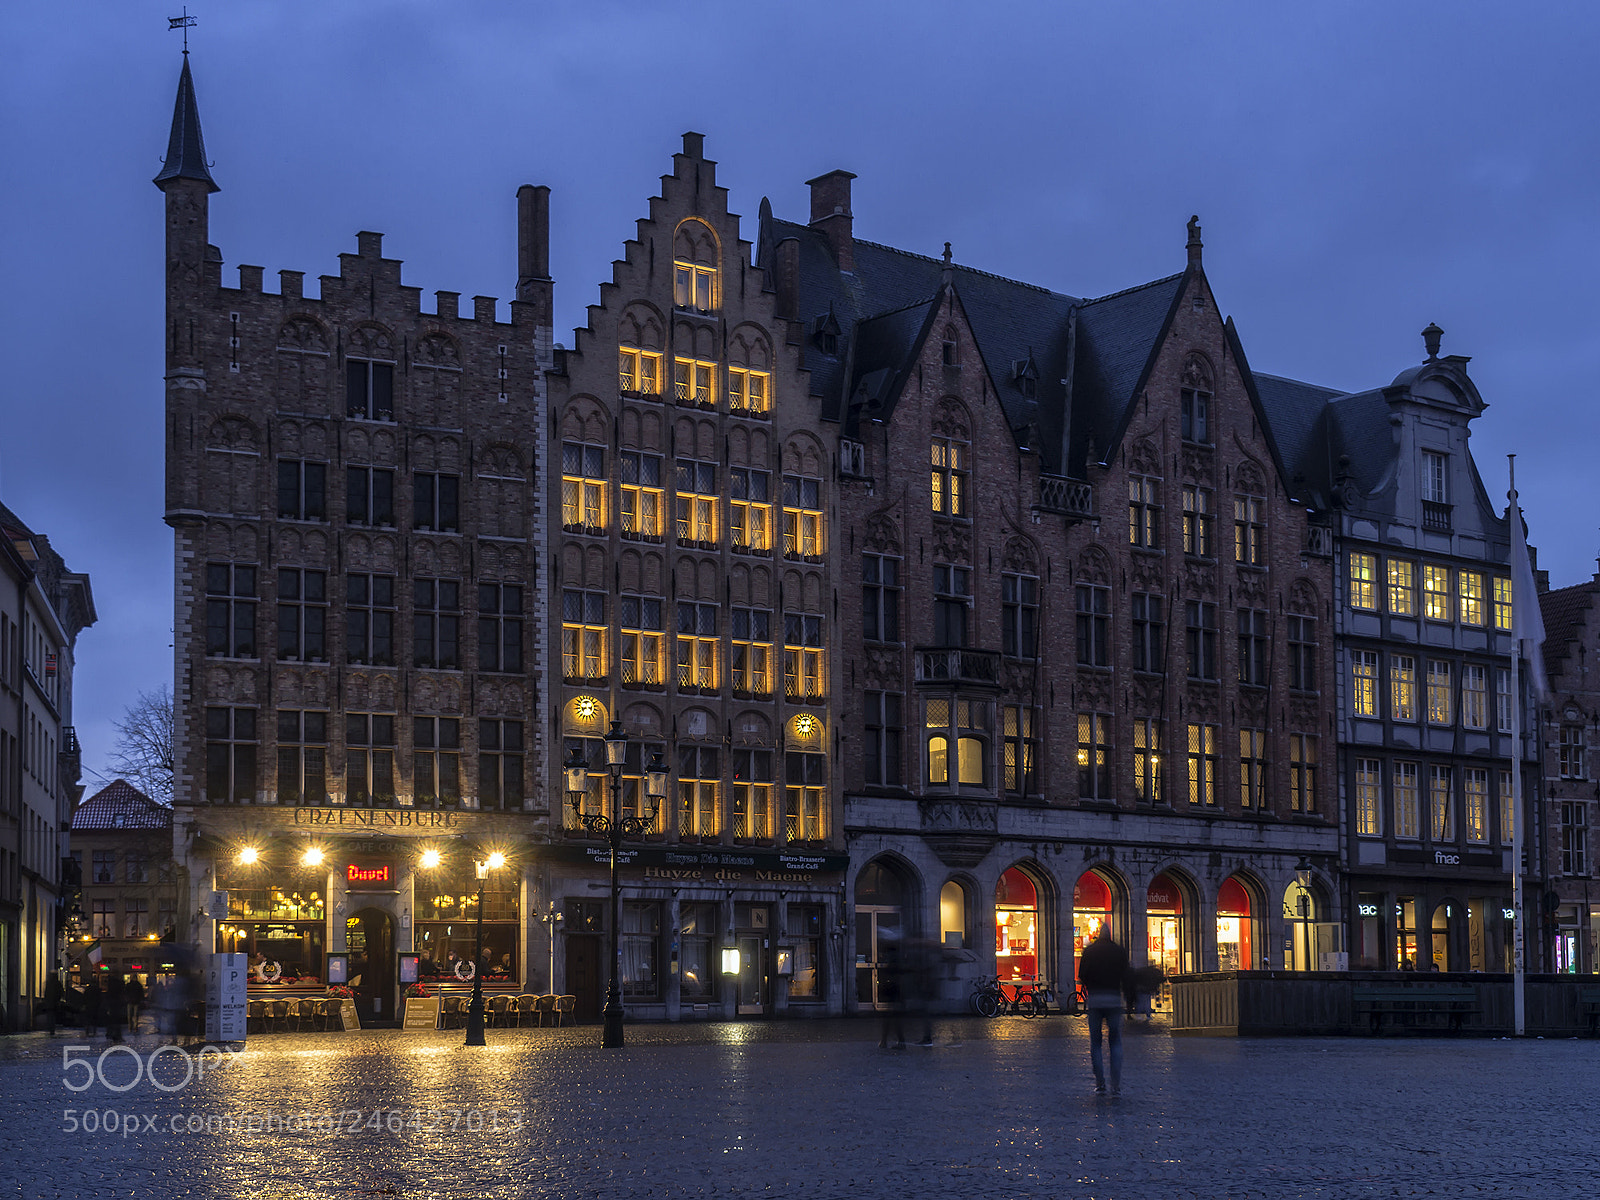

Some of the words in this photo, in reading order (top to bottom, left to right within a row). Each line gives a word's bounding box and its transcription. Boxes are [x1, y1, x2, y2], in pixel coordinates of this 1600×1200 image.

[1434, 851, 1460, 864] fnac
[347, 864, 389, 881] Duvel
[643, 866, 701, 880] Huyze
[714, 868, 741, 880] die
[755, 869, 812, 882] Maene
[1147, 892, 1169, 903] uidvat
[1358, 904, 1377, 916] nac
[231, 971, 238, 981] P
